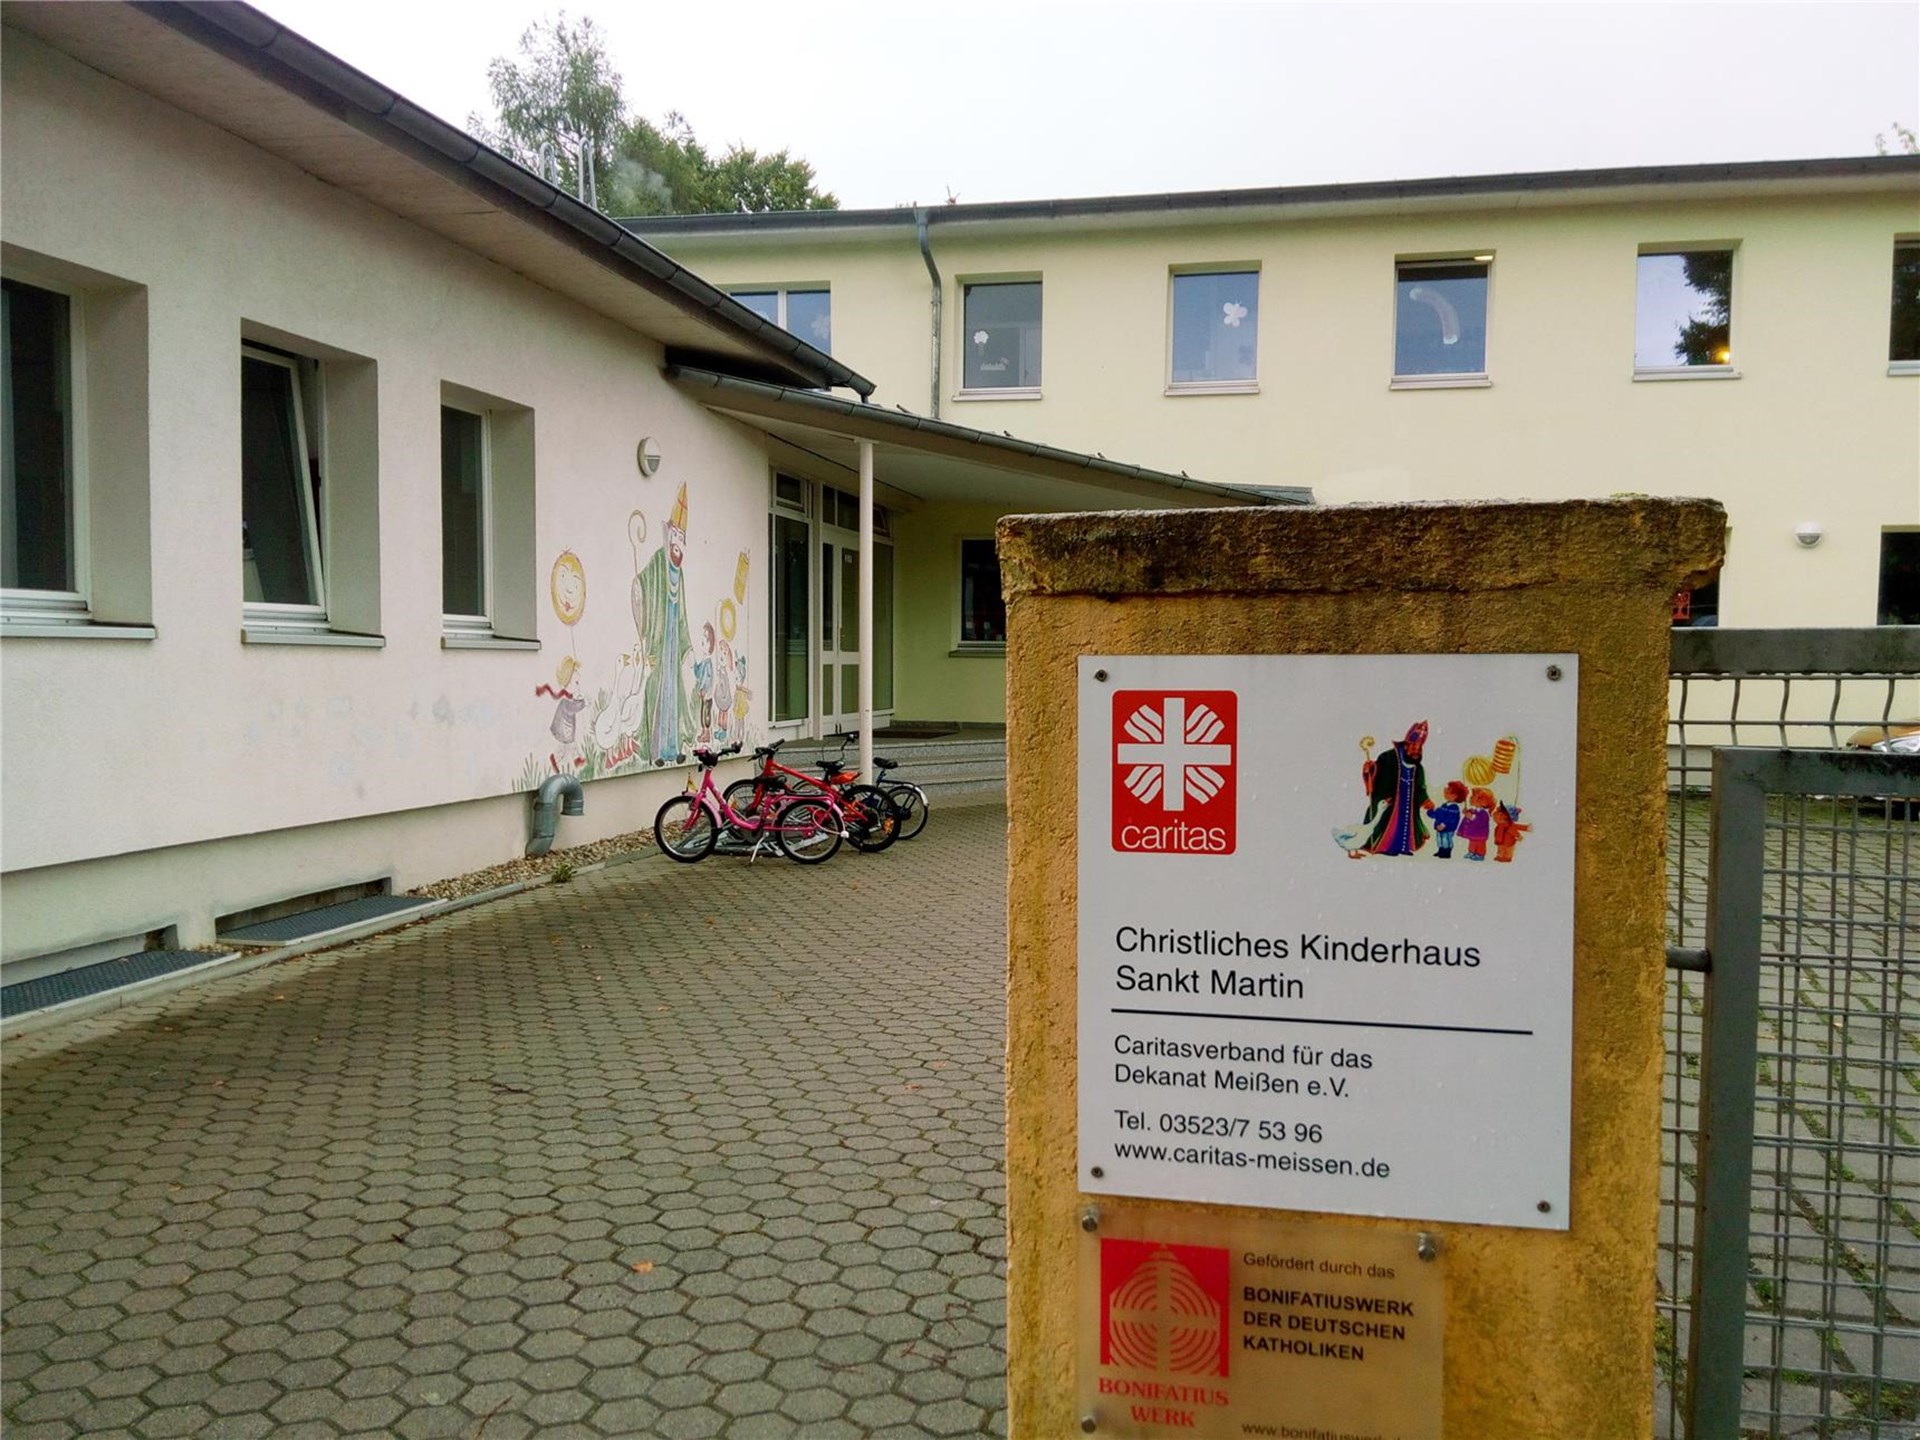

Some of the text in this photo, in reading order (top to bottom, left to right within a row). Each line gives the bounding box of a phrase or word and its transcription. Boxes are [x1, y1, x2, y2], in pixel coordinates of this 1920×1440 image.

[1120, 819, 1227, 851] caritas
[1115, 926, 1481, 968] Christliches Kinderhaus
[1115, 964, 1304, 999] Sankt Martin
[1114, 1034, 1373, 1069] Caritasverband für das
[1115, 1063, 1349, 1098] Dekanat Meißen e.V.
[1114, 1109, 1323, 1143] Tel. 03523/7 53 96
[1114, 1142, 1390, 1178] www.caritas-meissen.de
[1243, 1252, 1396, 1279] Gefördert durch das
[1243, 1285, 1415, 1318] BONIFATIUSWERK
[1243, 1310, 1406, 1341] DER DEUTSCHEN
[1243, 1334, 1365, 1362] KATHOLIKEN
[1098, 1377, 1230, 1407] BONIFATIUS
[1131, 1405, 1196, 1428] WERK
